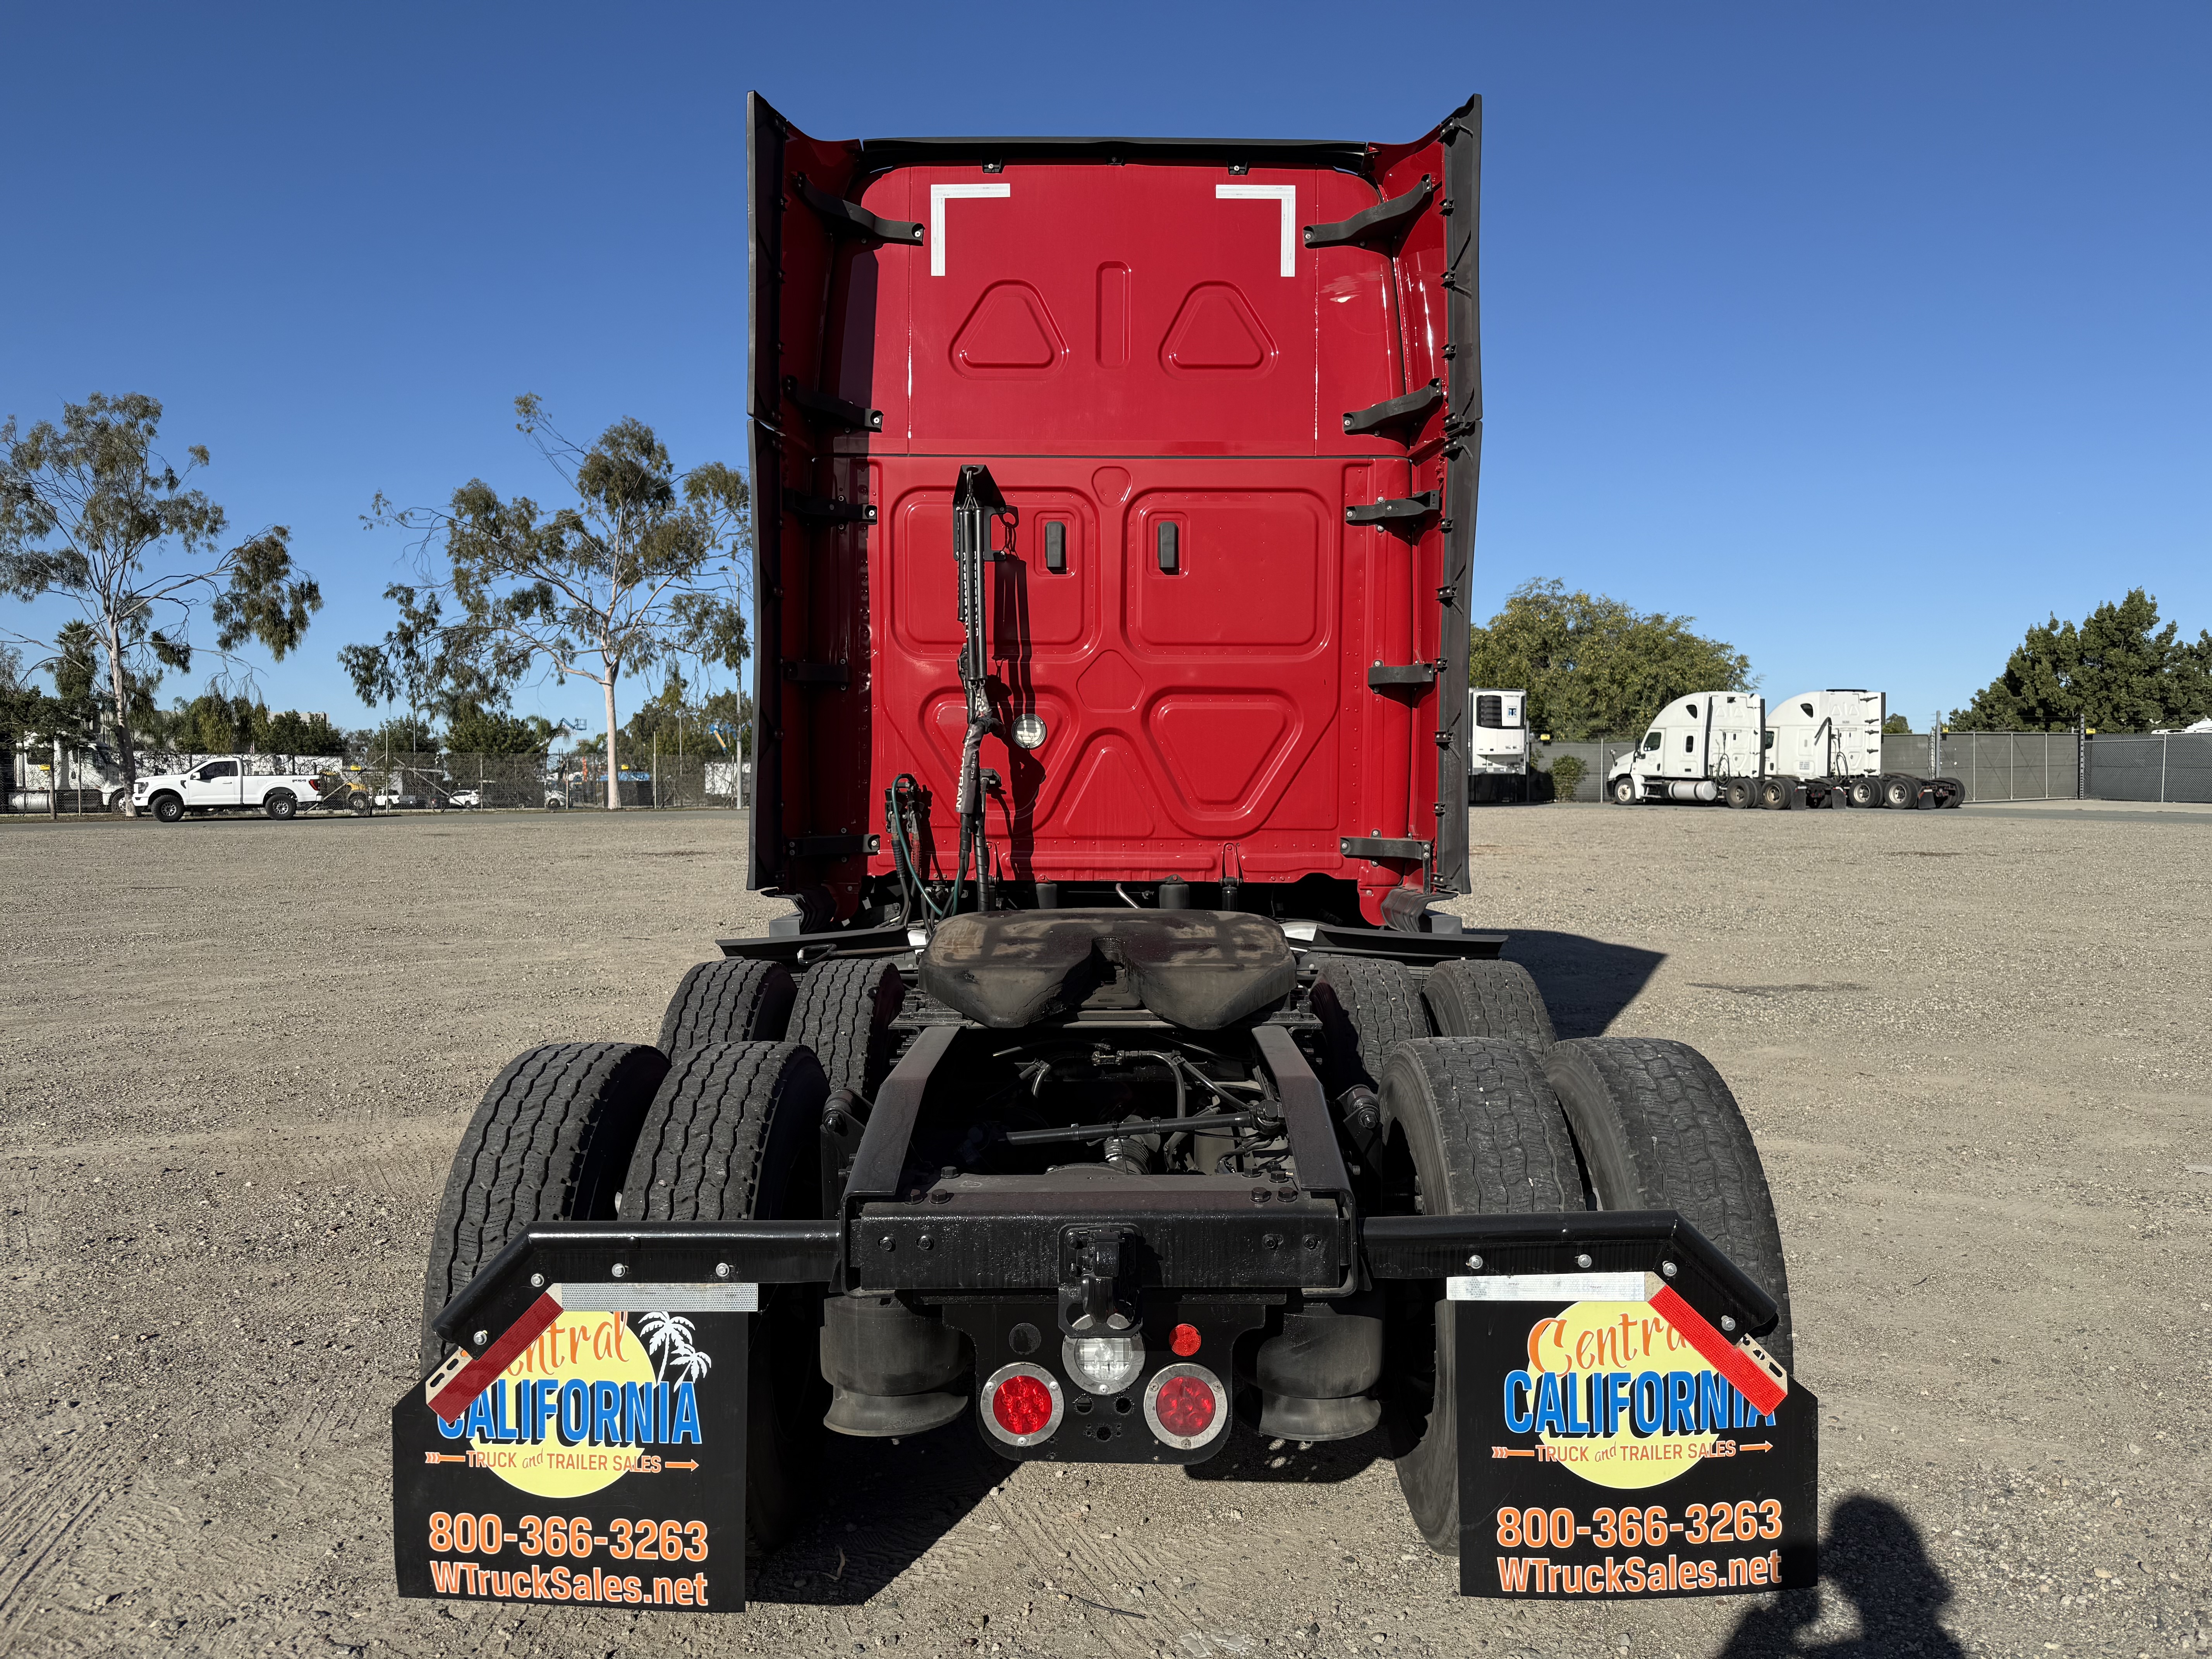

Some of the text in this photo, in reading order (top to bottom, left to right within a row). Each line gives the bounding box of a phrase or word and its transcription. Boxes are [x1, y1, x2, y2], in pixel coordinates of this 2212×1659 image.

[508, 1311, 629, 1376] ntral
[1528, 1313, 1687, 1377] Centra
[466, 1448, 661, 1473] TRUCK and TRAILER SALES
[1535, 1440, 1736, 1463] TRUCK and TRAILER SALES
[429, 1511, 708, 1562] 800-366-3263
[1496, 1499, 1782, 1548] 800-366-3263
[429, 1561, 708, 1606] WTruckSales.net
[1497, 1549, 1782, 1594] WTruckSales.net
